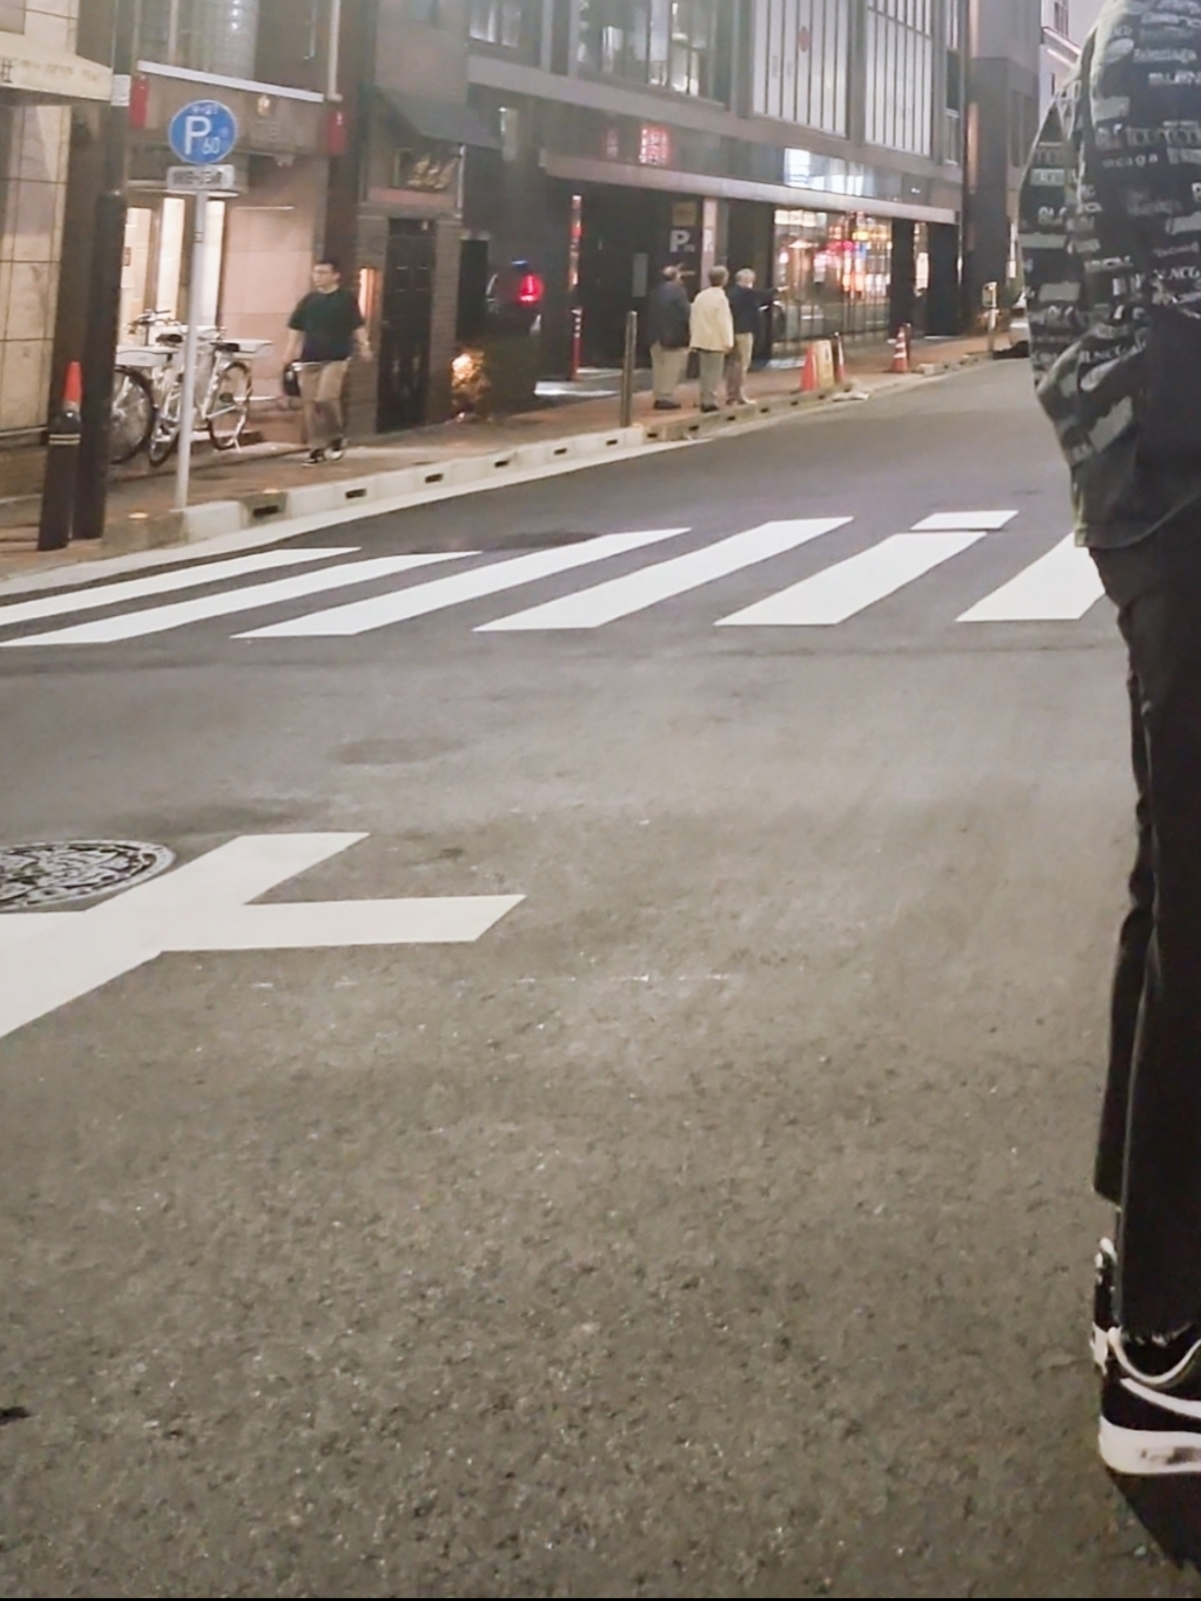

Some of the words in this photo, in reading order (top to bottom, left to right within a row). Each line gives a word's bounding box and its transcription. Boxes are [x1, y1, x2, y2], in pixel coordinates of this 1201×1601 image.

[184, 115, 213, 156] P
[203, 137, 221, 155] 60
[670, 230, 691, 253] P
